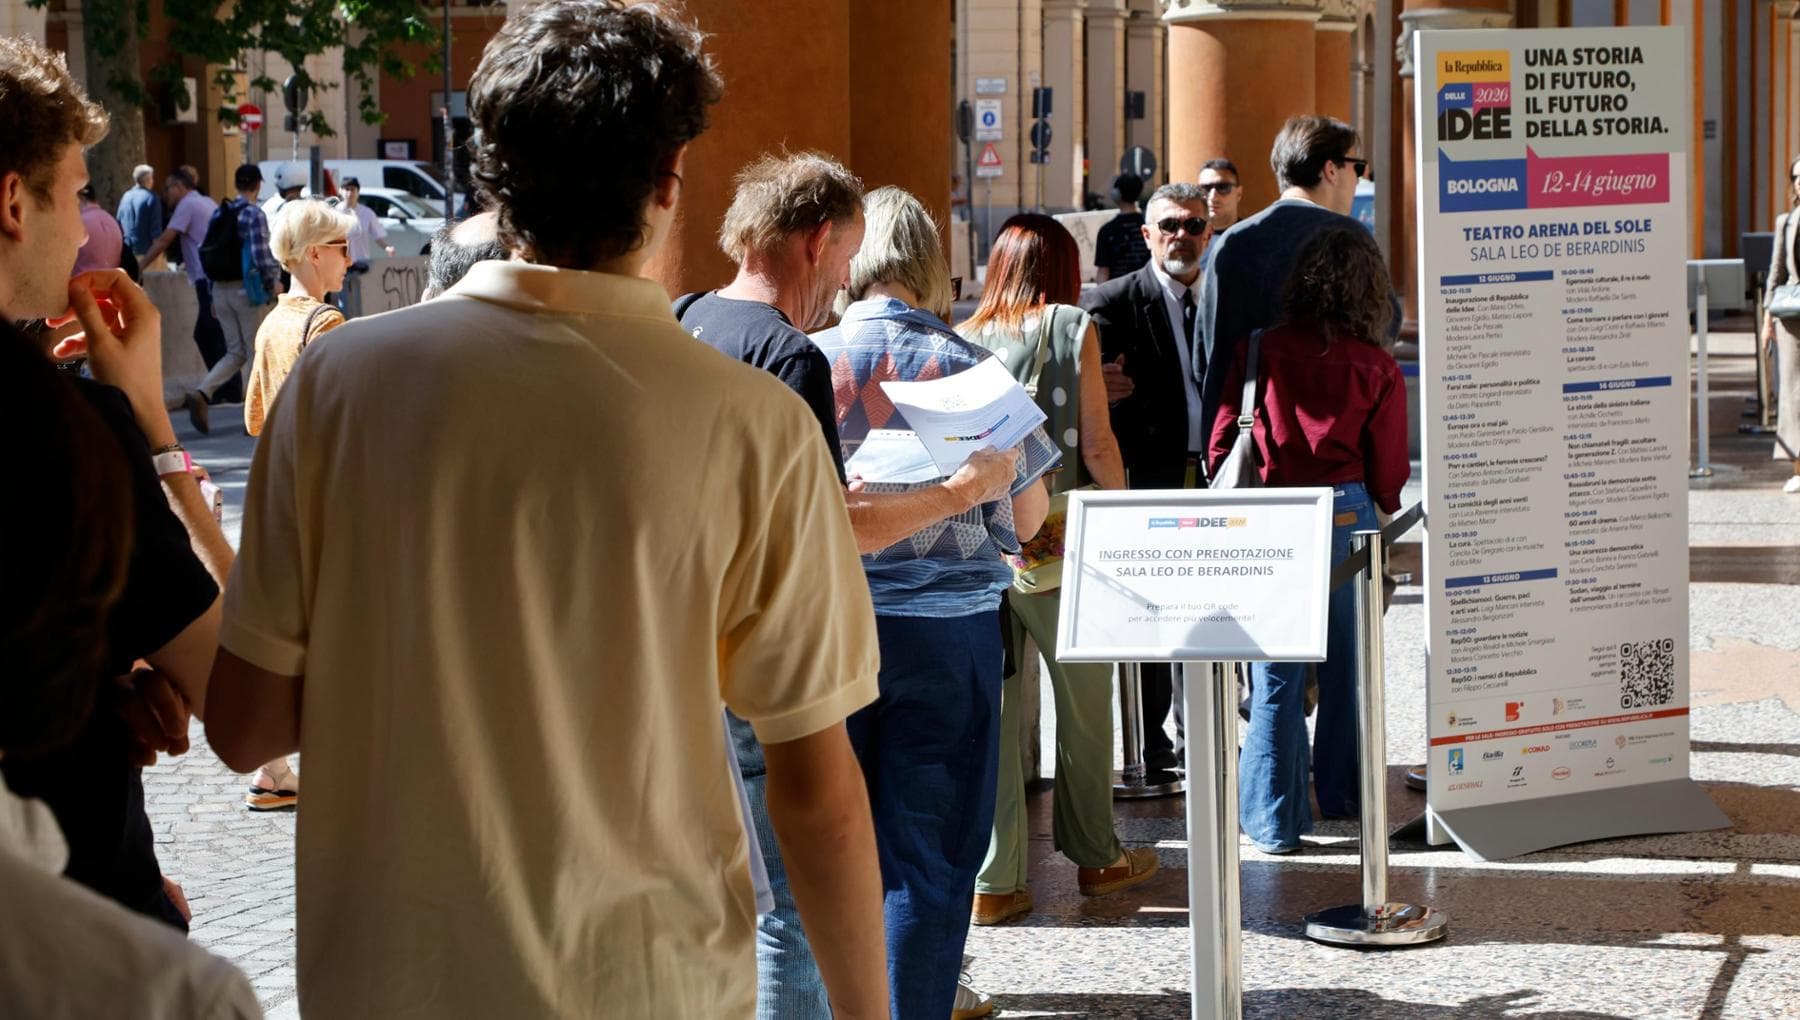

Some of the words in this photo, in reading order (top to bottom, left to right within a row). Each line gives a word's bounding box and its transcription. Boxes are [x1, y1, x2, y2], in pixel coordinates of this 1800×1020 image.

[1524, 48, 1568, 67] UNA
[1573, 46, 1644, 66] STORIA
[1445, 60, 1453, 73] la
[1454, 59, 1503, 75] Repubblica
[1525, 73, 1546, 91] DI
[1550, 71, 1636, 92] FUTURO,
[1444, 91, 1466, 100] DELLE
[1474, 87, 1509, 103] 2026
[1525, 97, 1543, 114] IL
[1548, 94, 1628, 114] FUTURO
[1437, 107, 1512, 141] IDEE
[1526, 119, 1588, 138] DELLA
[1592, 116, 1669, 136] STORIA.
[1447, 177, 1519, 194] BOLOGNA
[1541, 170, 1592, 193] 12-14
[1592, 169, 1657, 197] giugno
[1463, 225, 1524, 241] TEATRO
[1528, 222, 1580, 238] ARENA
[1582, 221, 1611, 236] DEL
[1615, 218, 1652, 233] SOLE
[1470, 246, 1506, 261] SALA
[1511, 244, 1539, 259] LEO
[1544, 243, 1562, 257] DE
[1566, 238, 1645, 256] BERARDINIS
[1487, 274, 1515, 282] GIUGNO
[1445, 295, 1487, 305] Inaugurazione
[1496, 293, 1528, 302] Repubblica
[1479, 379, 1512, 389] personalità
[1518, 377, 1539, 386] politica
[1608, 380, 1635, 388] GIUGNO
[1448, 422, 1468, 430] Europa
[1574, 449, 1609, 459] generazione
[1608, 476, 1639, 484] democrazia
[1483, 498, 1497, 506] degli
[1196, 517, 1228, 527] IDEE
[1609, 543, 1643, 552] democratica
[1099, 550, 1162, 560] INGRESSO
[1165, 550, 1193, 559] CON
[1196, 548, 1294, 559] PRENOTAZIONE
[1115, 567, 1147, 577] SALA
[1150, 567, 1174, 577] LEO
[1177, 567, 1194, 576] DE
[1197, 566, 1274, 576] BERARDINIS
[1491, 572, 1519, 583] GIUGNO
[1590, 584, 1611, 593] viaggio
[1146, 601, 1178, 611] Prepara
[1187, 602, 1202, 610] tuo
[1203, 602, 1217, 611] QR
[1218, 602, 1239, 610] code
[1145, 614, 1181, 622] accedere
[1199, 614, 1256, 622] velocemente!
[1474, 633, 1500, 643] guardare
[1508, 630, 1527, 638] notizie
[1505, 667, 1536, 678] Repubblica
